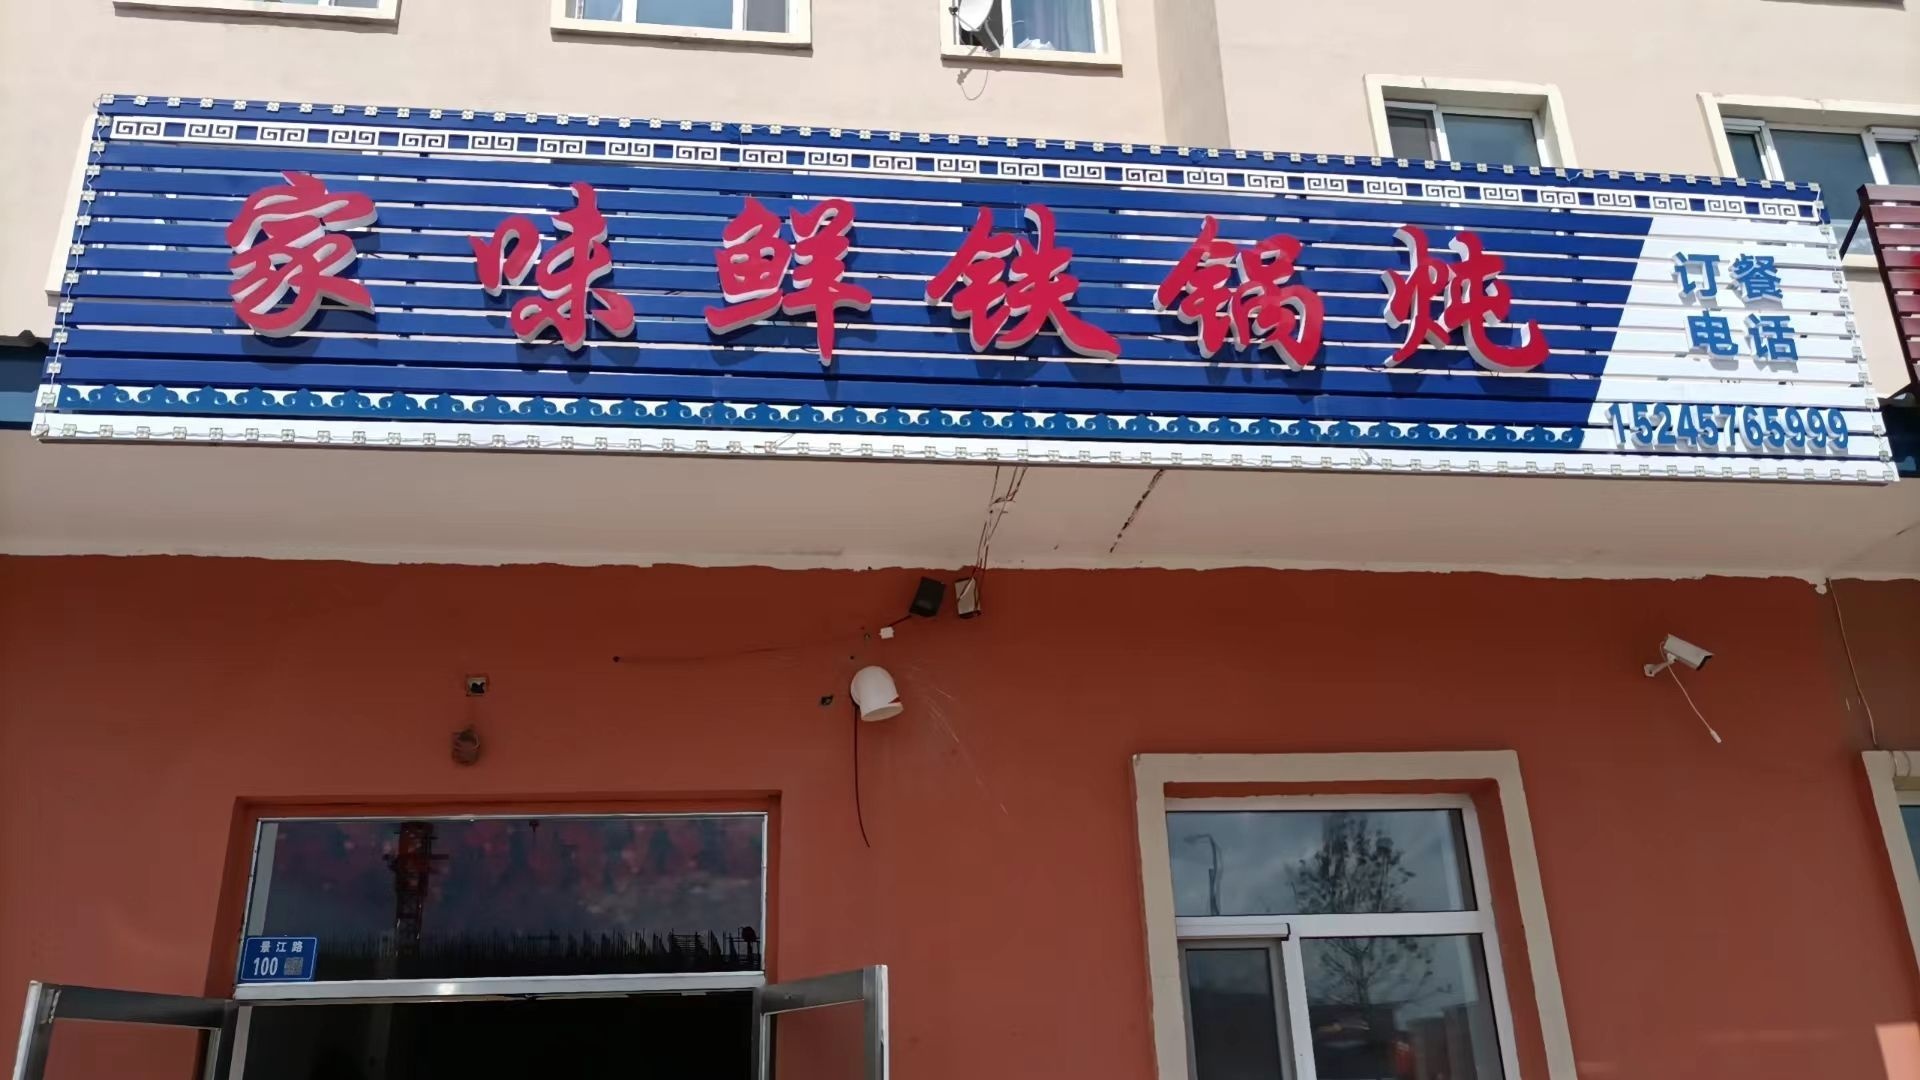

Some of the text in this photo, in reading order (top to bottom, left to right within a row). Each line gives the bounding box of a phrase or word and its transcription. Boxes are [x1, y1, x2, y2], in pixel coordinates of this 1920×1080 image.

[225, 171, 1550, 373] 家味鲜铁锅炖
[1673, 252, 1783, 301] 订餐
[1687, 310, 1799, 362] 电话
[1607, 402, 1849, 449] 15245765999
[253, 957, 279, 976] 100
[260, 941, 303, 953] 景江路
